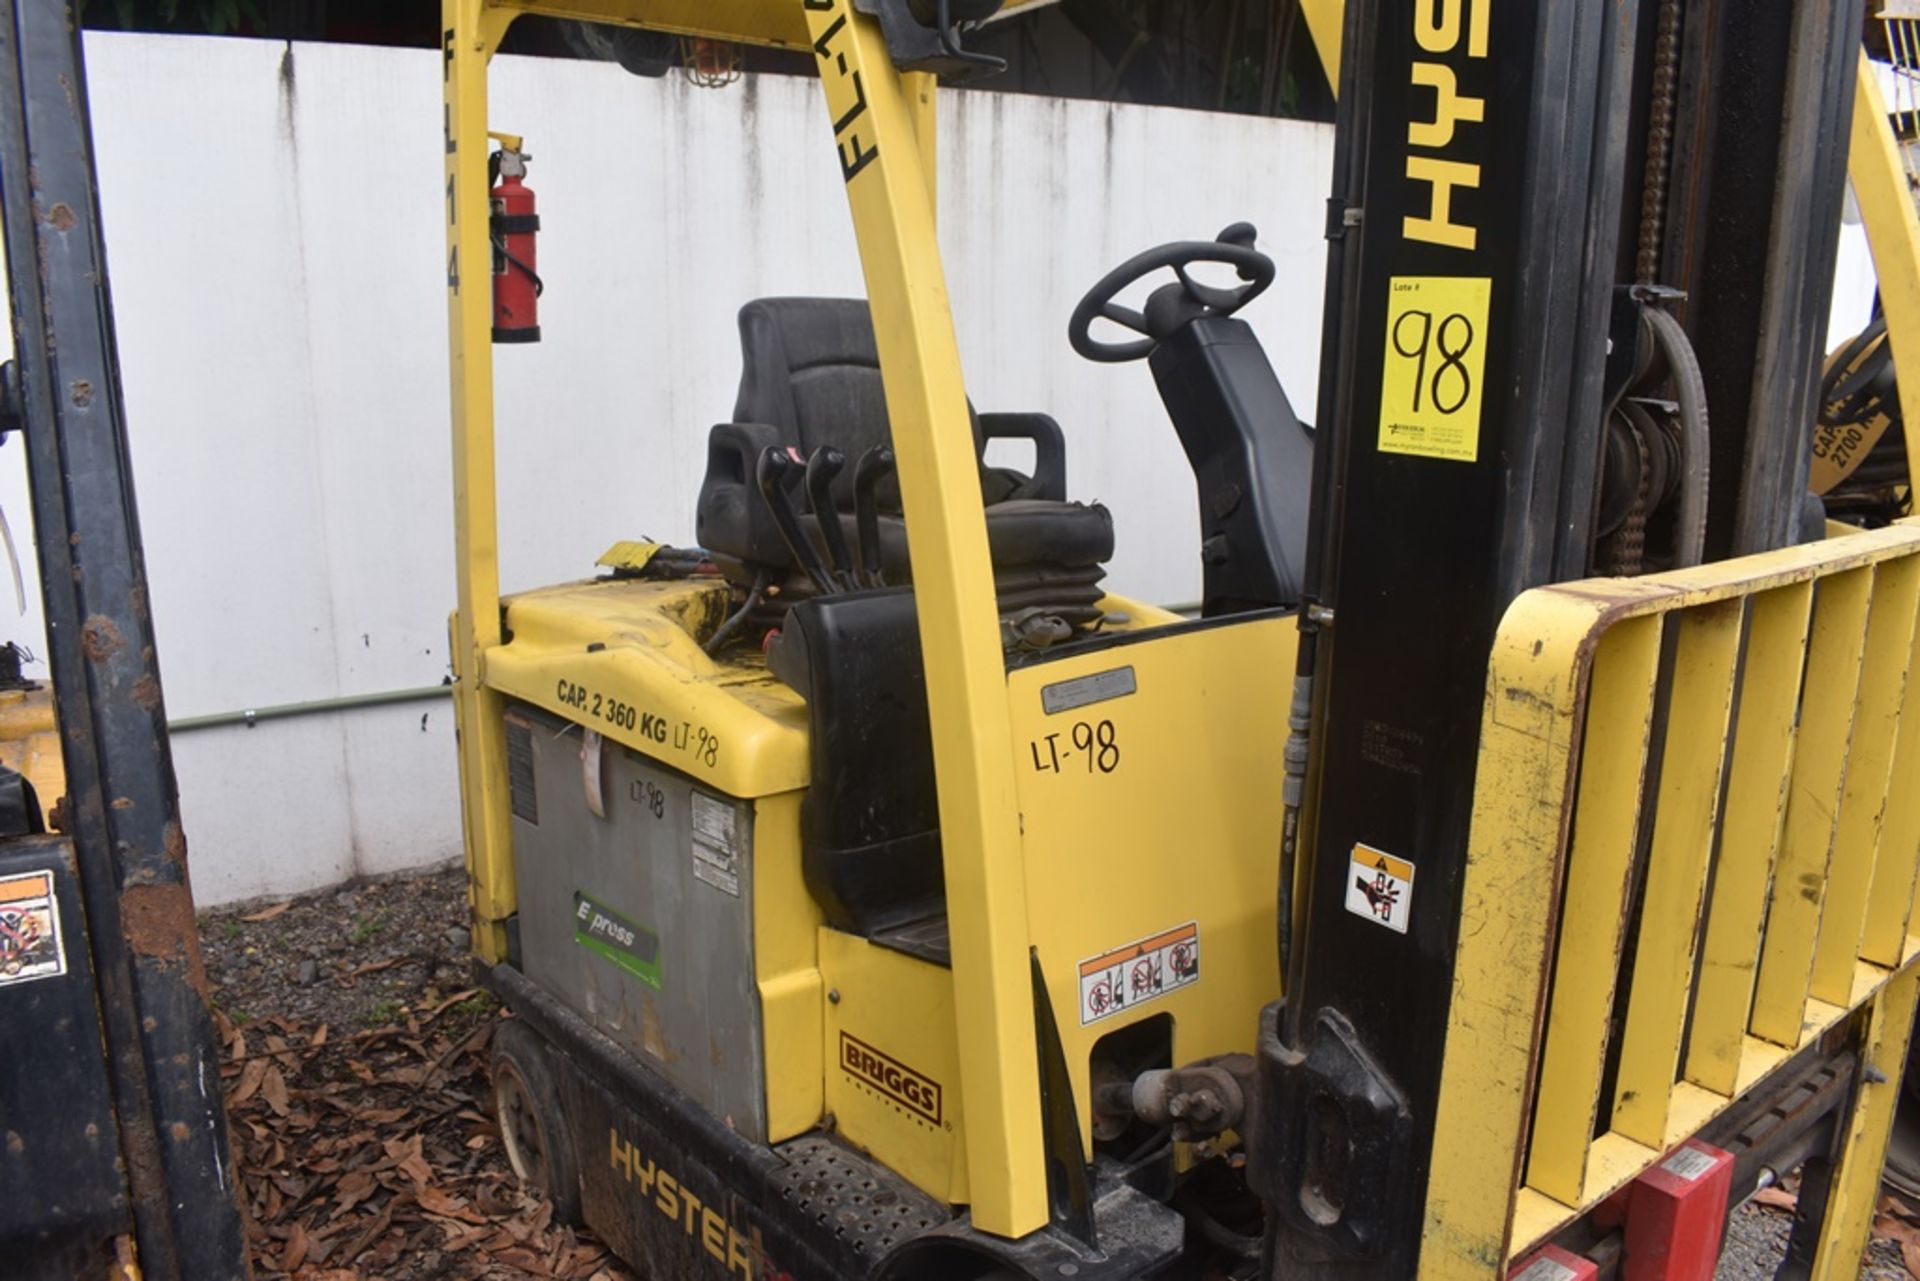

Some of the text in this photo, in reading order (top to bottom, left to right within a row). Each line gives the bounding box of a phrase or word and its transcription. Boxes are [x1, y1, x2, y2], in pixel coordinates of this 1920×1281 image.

[1393, 283, 1412, 291] Lote
[1392, 310, 1474, 414] 98
[1830, 427, 1863, 469] 2700
[557, 678, 667, 743] CAP. 2 360 KG
[674, 721, 719, 768] LT-98
[1030, 719, 1120, 773] LT-98
[577, 900, 635, 946] Epress
[846, 1042, 935, 1112] BRIGGS
